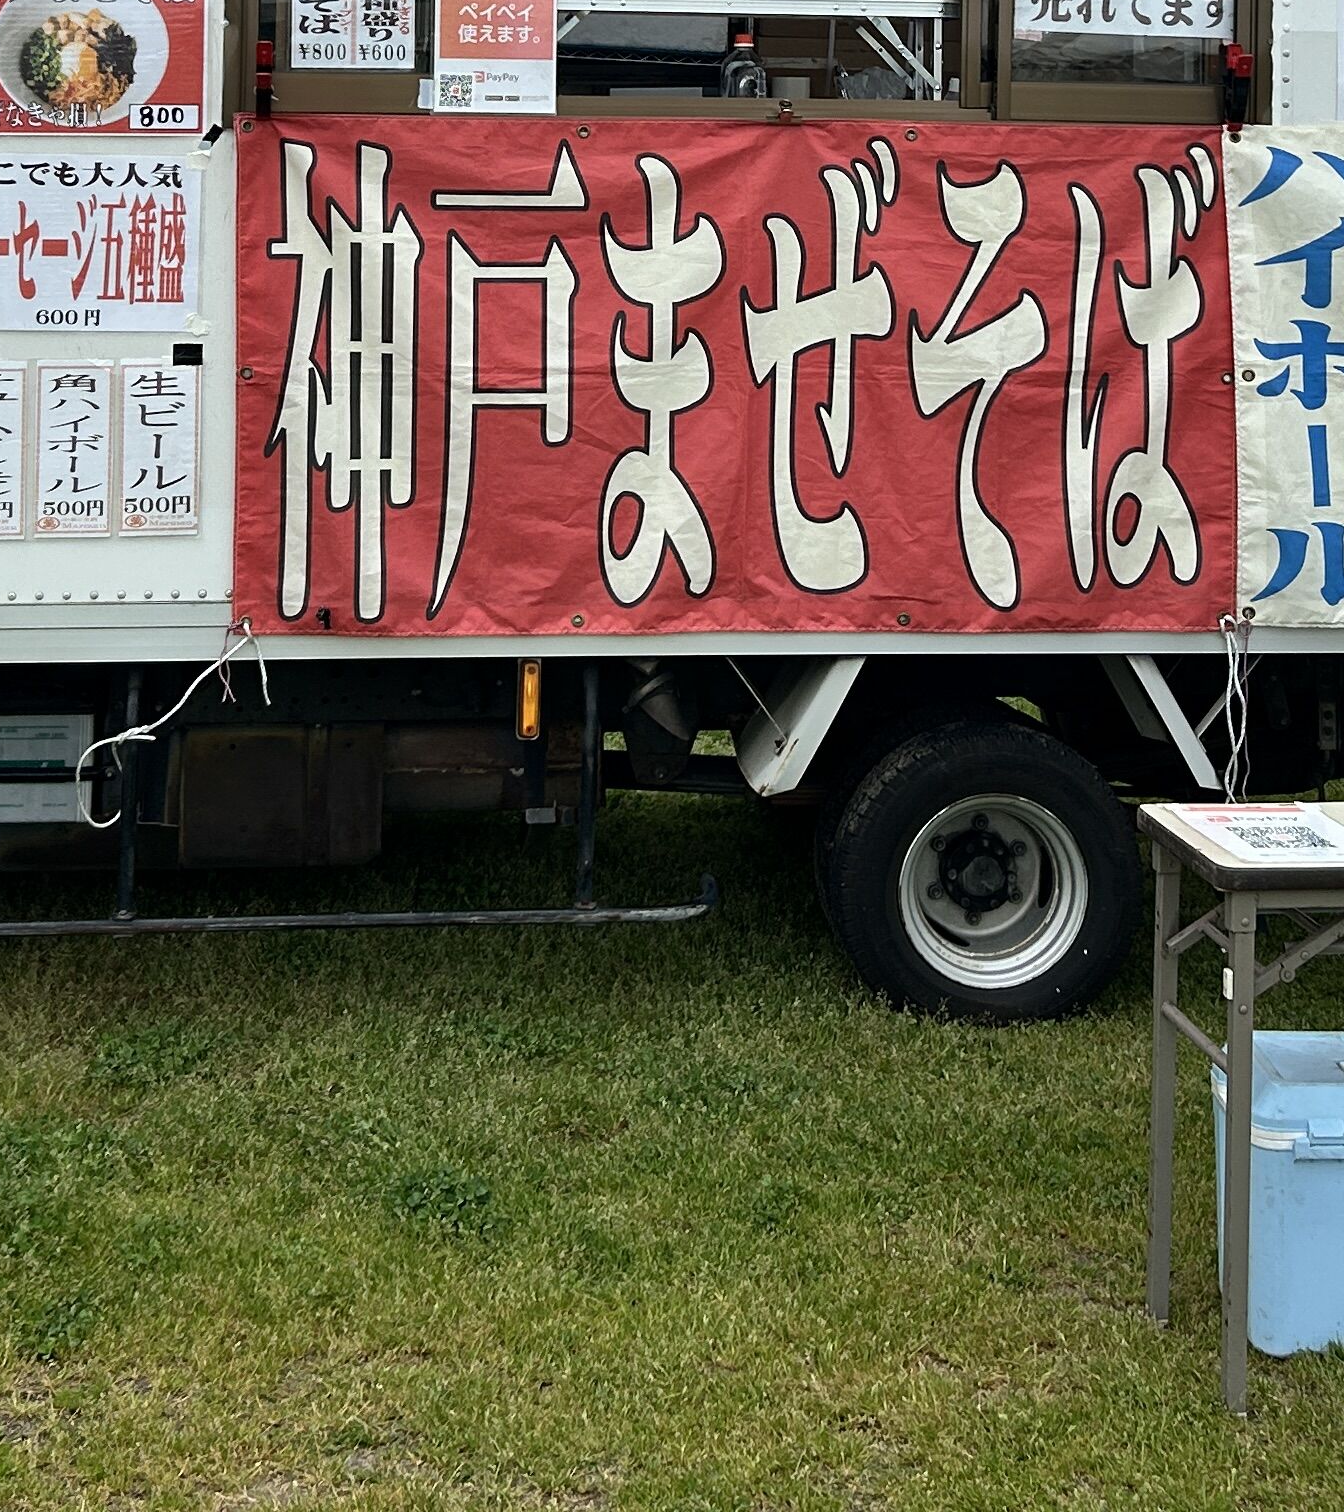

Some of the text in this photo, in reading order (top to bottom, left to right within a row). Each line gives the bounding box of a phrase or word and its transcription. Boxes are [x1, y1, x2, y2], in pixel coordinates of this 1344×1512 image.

[458, 2, 534, 22] ペイペイ
[458, 24, 541, 44] 使えます。
[298, 43, 347, 61] ¥800
[358, 44, 406, 61] ¥600
[487, 73, 519, 83] PayPay
[139, 105, 185, 127] 800
[35, 309, 101, 328] 600円
[264, 136, 1218, 624] 神戸まぜそば
[46, 373, 104, 493] 角ハイボール
[130, 371, 189, 491] 生ビール
[42, 500, 104, 517] 500円
[123, 495, 191, 514] 500円
